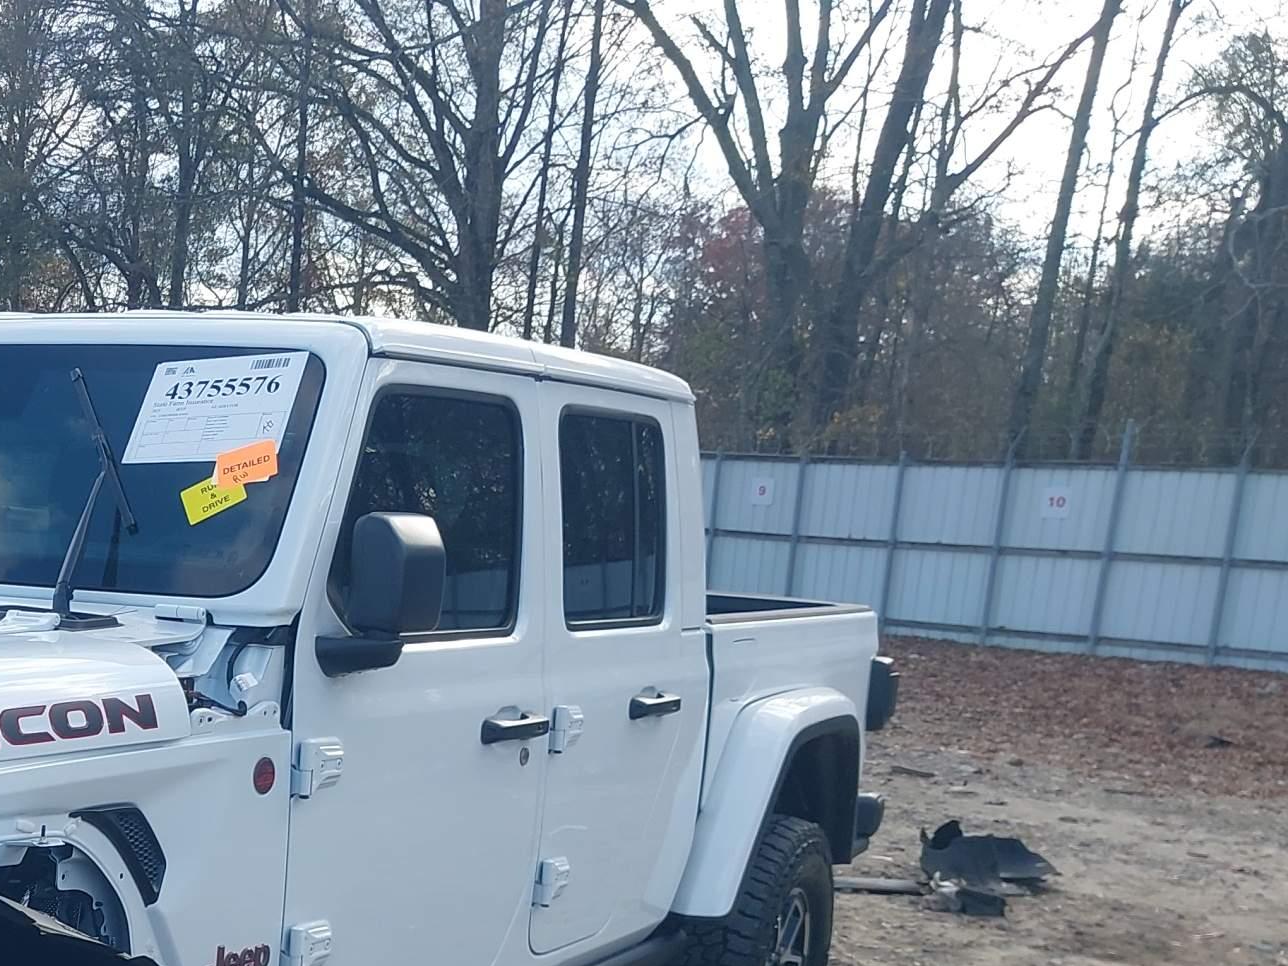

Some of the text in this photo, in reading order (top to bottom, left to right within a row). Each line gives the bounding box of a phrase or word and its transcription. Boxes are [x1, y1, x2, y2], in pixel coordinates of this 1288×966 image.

[165, 374, 283, 400] 43755576
[222, 454, 271, 475] DETAILED
[200, 484, 217, 495] RU
[210, 492, 217, 500] &
[201, 494, 231, 514] DRIVE
[1048, 495, 1067, 509] 10
